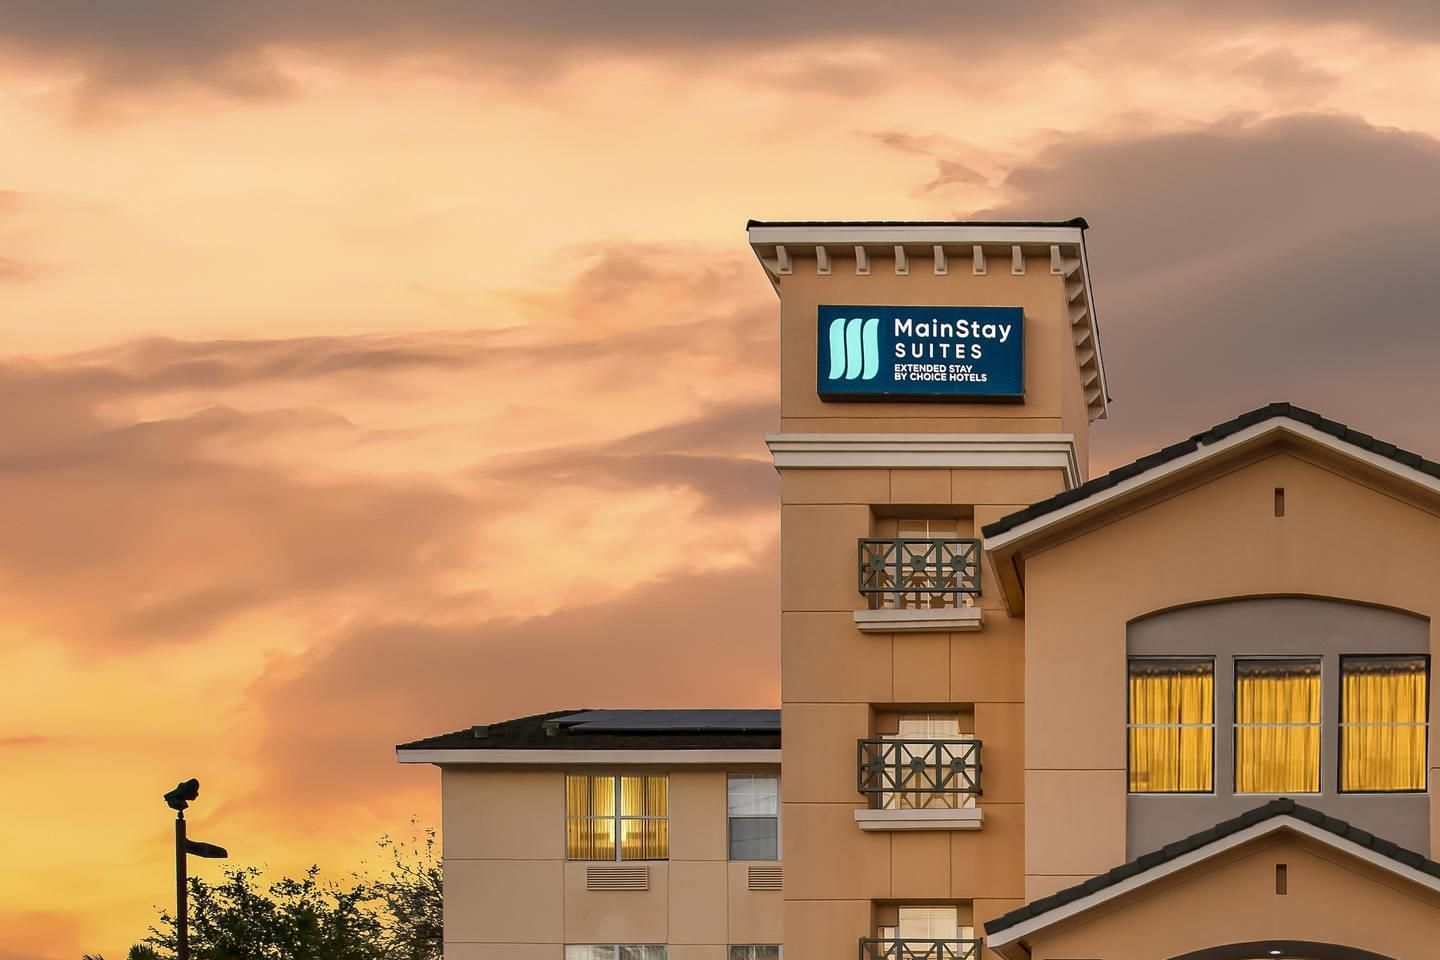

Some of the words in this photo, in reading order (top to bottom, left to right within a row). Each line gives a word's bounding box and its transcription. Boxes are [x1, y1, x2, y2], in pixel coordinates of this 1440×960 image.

[894, 318, 1012, 343] MainStay
[895, 342, 982, 359] SUITES
[894, 363, 947, 373] EXTENDED
[948, 364, 973, 373] STAY
[894, 372, 906, 381] BY
[909, 372, 947, 381] CHOICE
[949, 373, 988, 382] HOTELS
